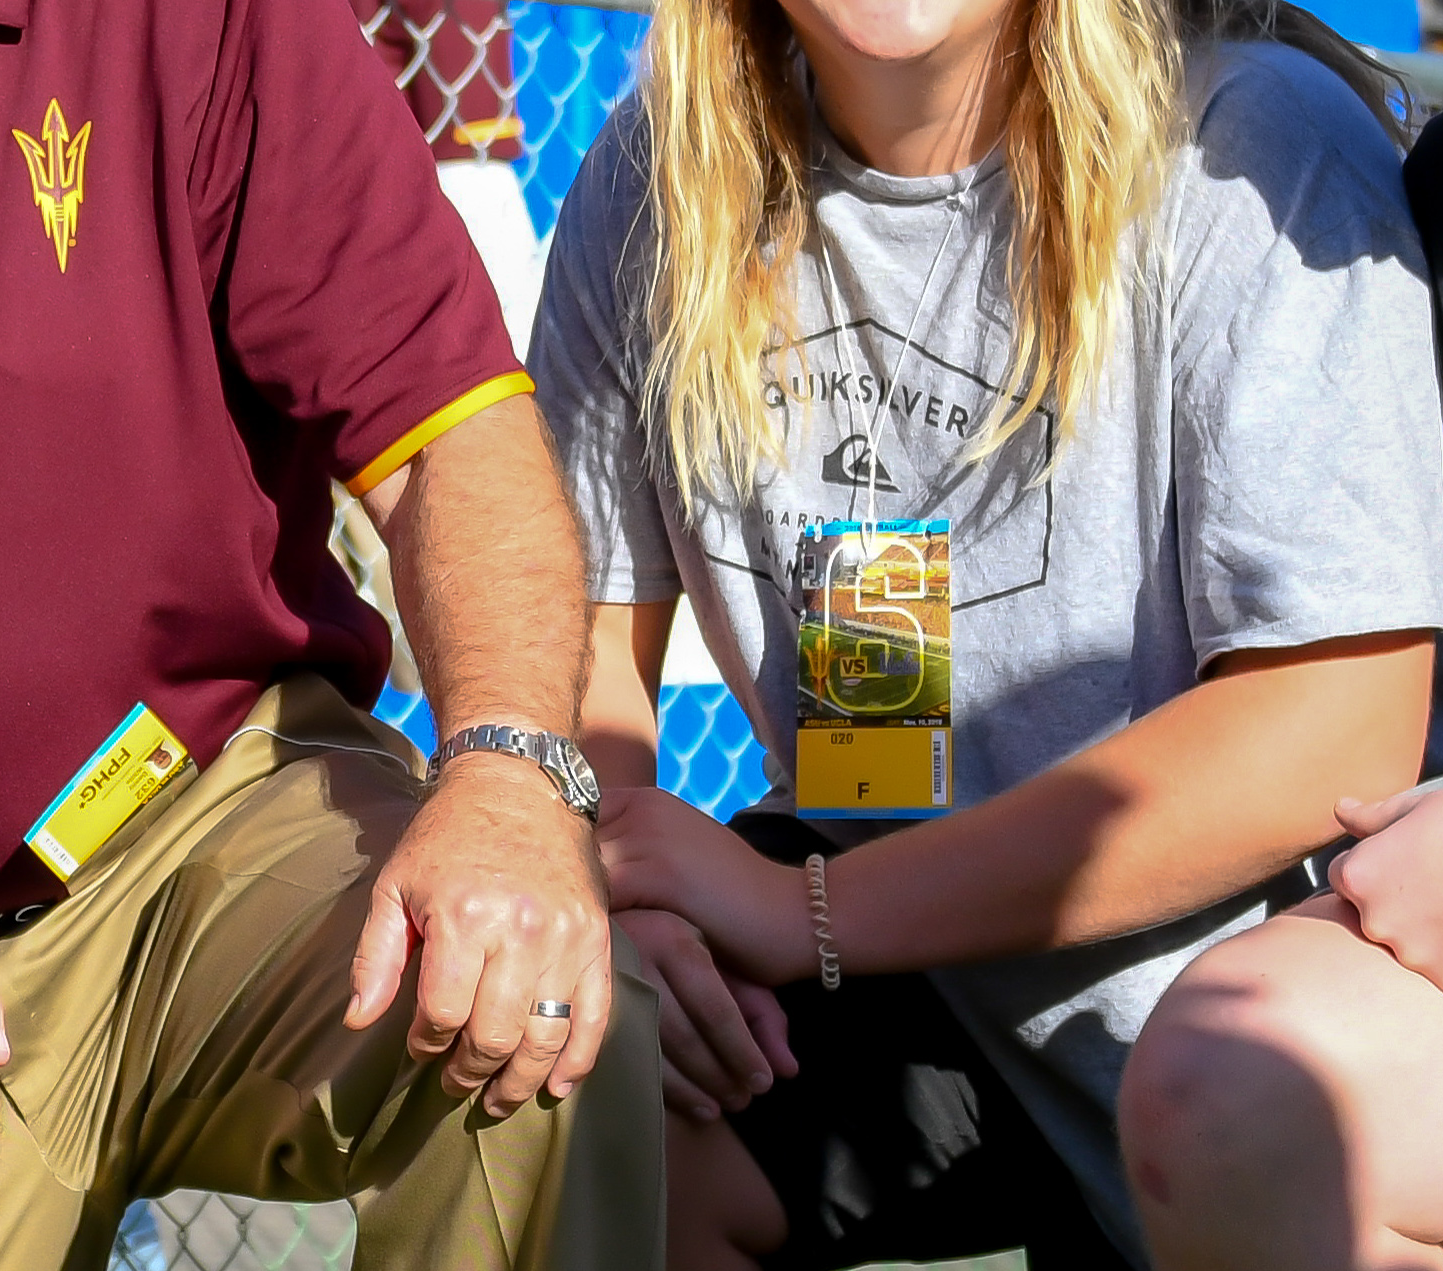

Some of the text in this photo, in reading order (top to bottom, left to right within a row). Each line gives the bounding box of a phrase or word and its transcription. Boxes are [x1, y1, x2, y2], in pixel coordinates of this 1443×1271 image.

[764, 370, 970, 438] QUIKSILVER
[842, 658, 866, 674] VS
[829, 732, 854, 745] 020
[135, 776, 157, 801] 632
[857, 781, 871, 800] F
